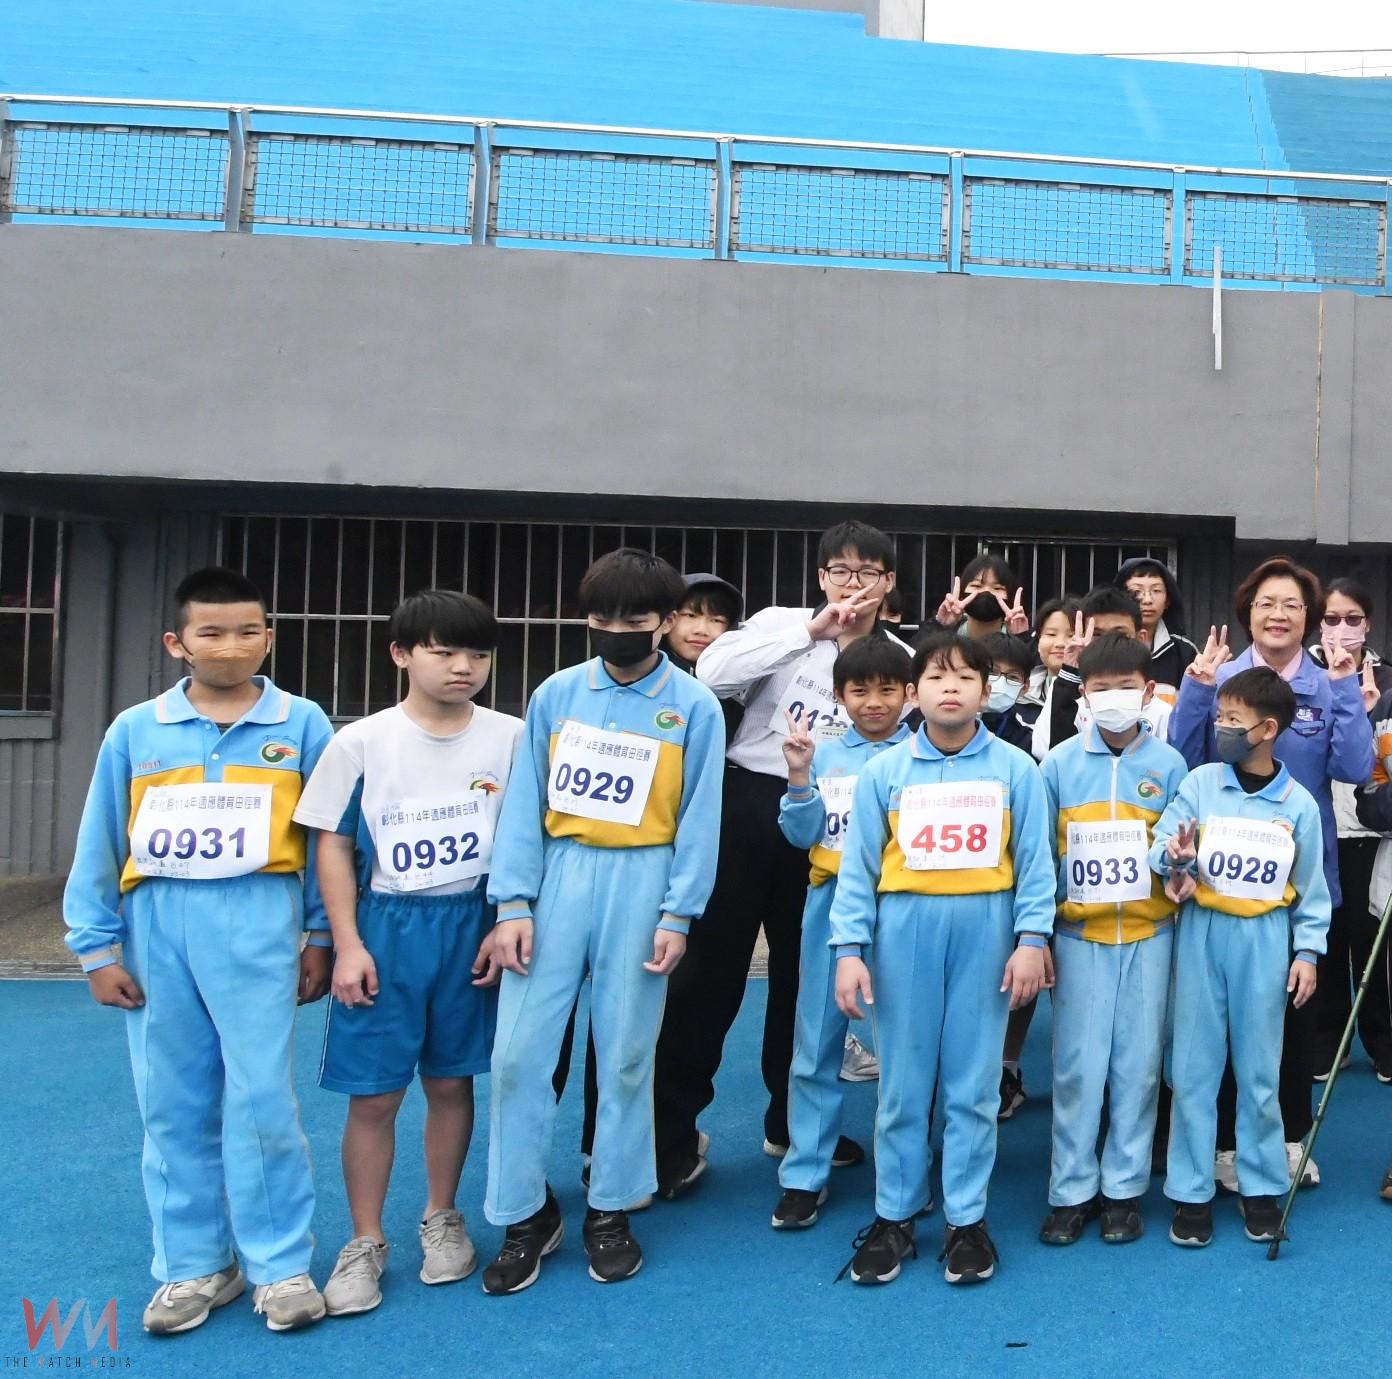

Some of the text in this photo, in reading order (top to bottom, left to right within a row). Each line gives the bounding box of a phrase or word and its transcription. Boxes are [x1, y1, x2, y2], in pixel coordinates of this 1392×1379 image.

[556, 763, 634, 804] 0929
[148, 828, 246, 859] 0931
[392, 832, 479, 873] 0932
[911, 824, 987, 853] 458
[1073, 857, 1139, 886] 0933
[1208, 851, 1278, 884] 0928
